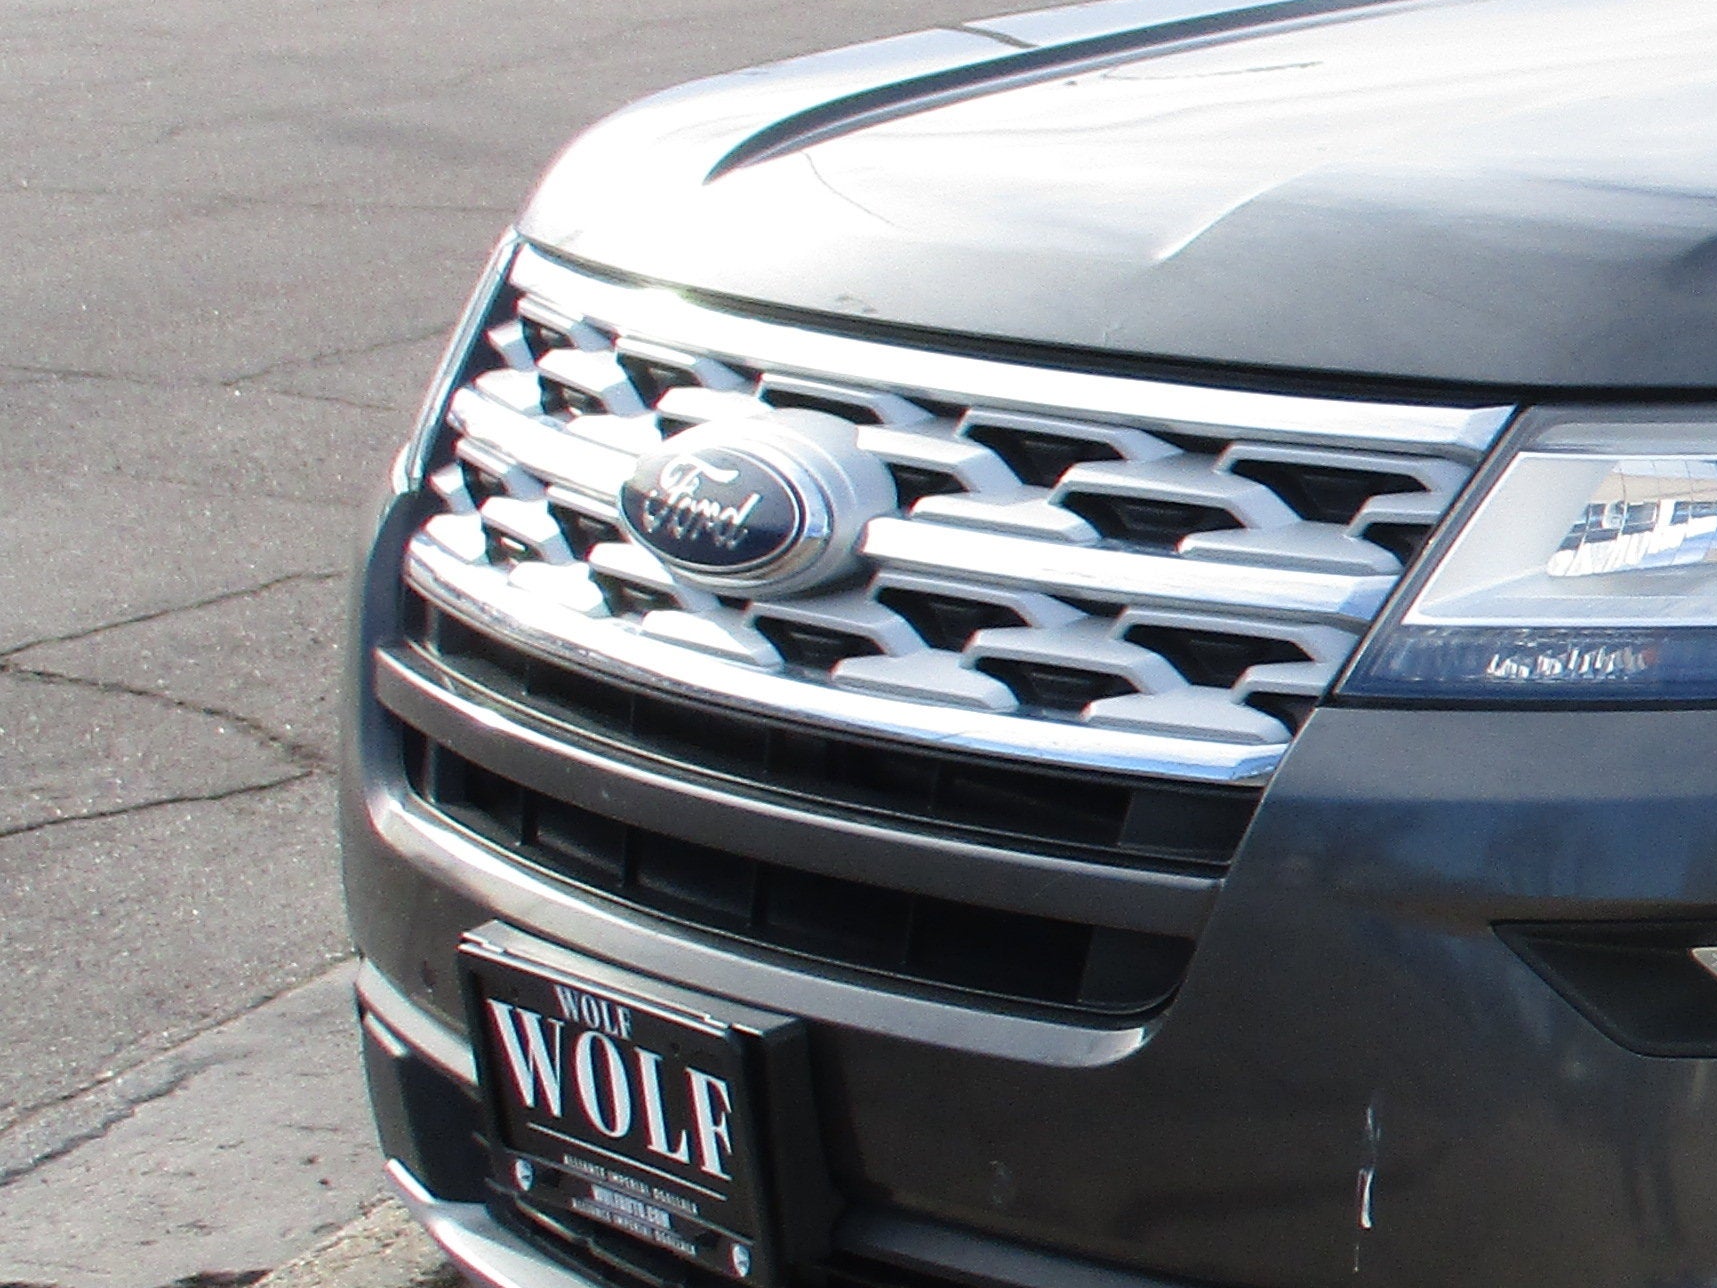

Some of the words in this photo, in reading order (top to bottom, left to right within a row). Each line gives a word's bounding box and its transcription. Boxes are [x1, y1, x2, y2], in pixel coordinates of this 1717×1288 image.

[642, 455, 762, 550] Ford
[553, 983, 633, 1041] WOLF
[485, 998, 734, 1182] WOLF
